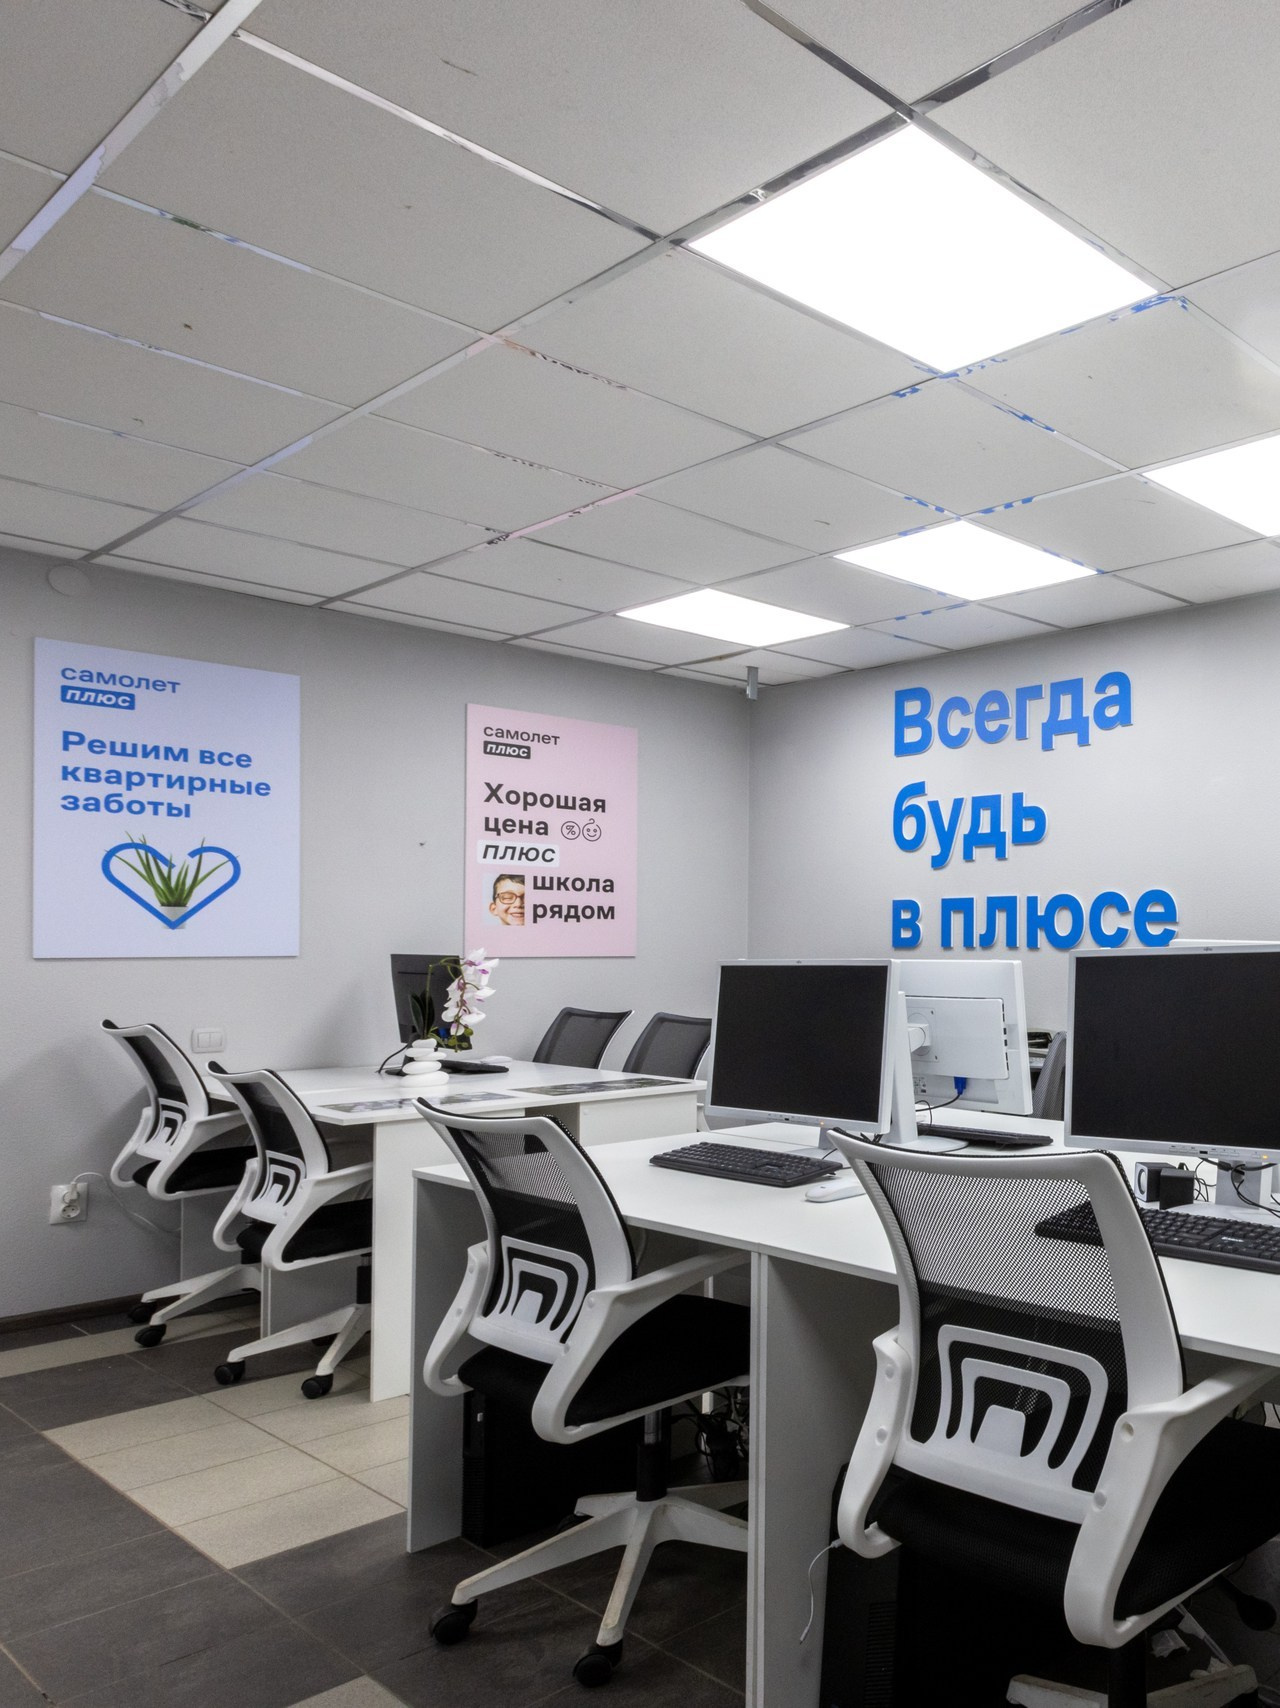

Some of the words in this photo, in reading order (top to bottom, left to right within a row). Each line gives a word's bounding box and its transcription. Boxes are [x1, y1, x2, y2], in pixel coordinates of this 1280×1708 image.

[60, 667, 181, 694] самолет
[893, 671, 1134, 758] Всегда
[62, 730, 189, 763] Решим
[199, 749, 252, 769] все
[483, 726, 560, 746] самолет
[61, 765, 271, 797] квартирные
[60, 792, 192, 818] заботы
[484, 782, 607, 813] Хорошая
[484, 816, 549, 837] цена
[892, 780, 1048, 870] будь
[532, 875, 615, 893] школа
[532, 903, 616, 924] рядом
[891, 898, 923, 950] в
[940, 888, 1179, 950] плюсе
